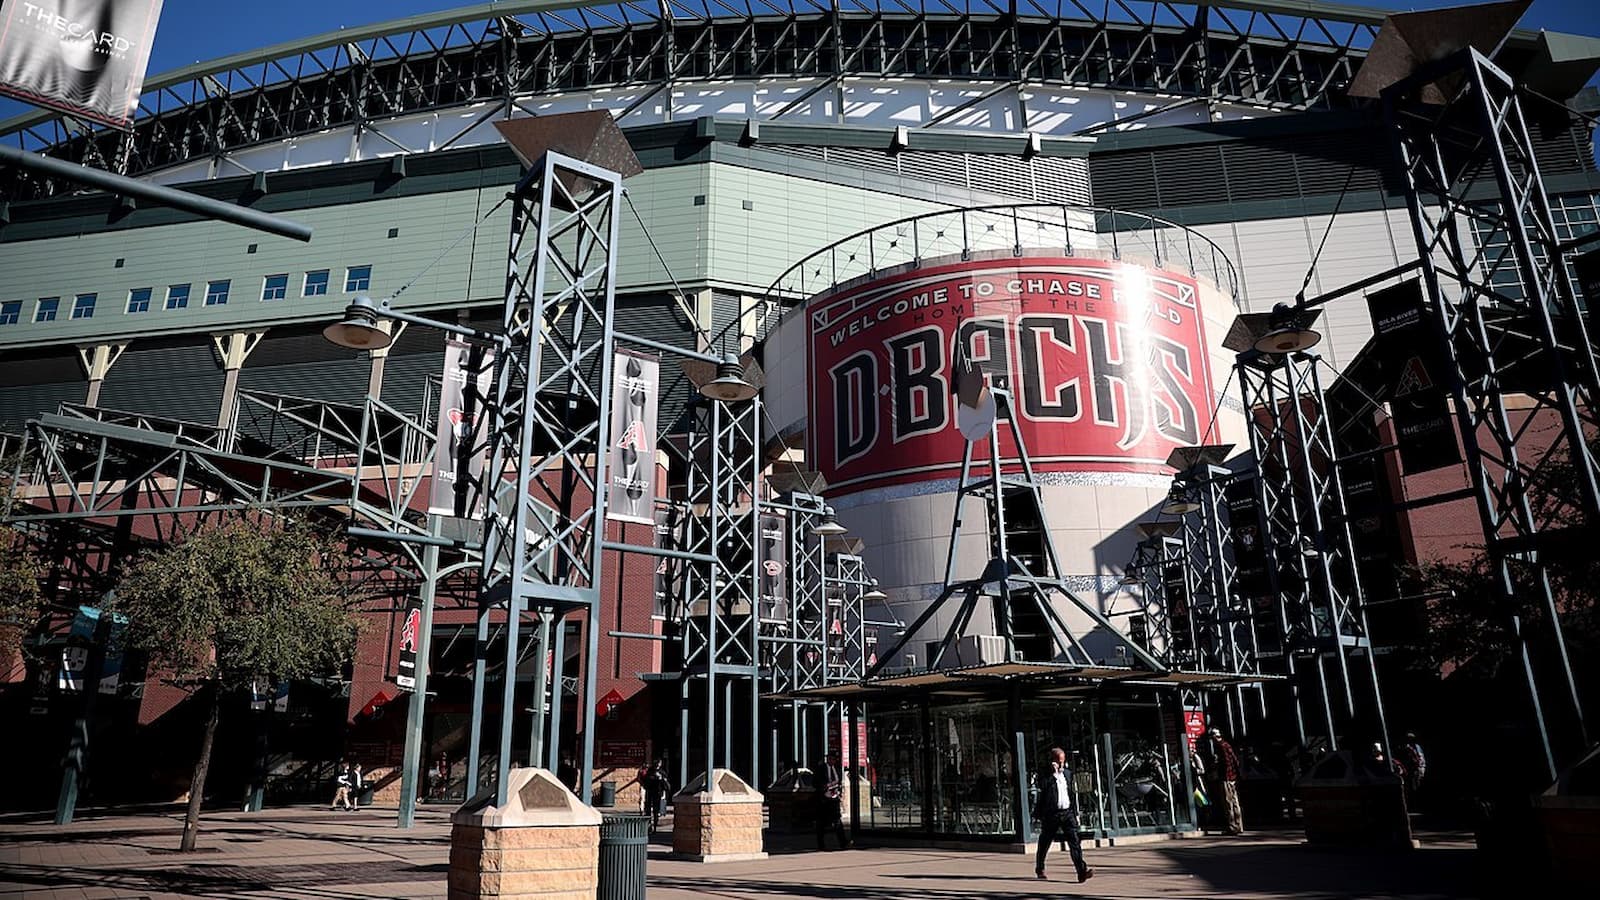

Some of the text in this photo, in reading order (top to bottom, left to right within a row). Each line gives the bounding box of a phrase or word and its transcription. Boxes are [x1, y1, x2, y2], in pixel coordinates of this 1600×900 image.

[830, 279, 1182, 347] WELCOME TO CHASE FLD
[913, 303, 981, 324] HOME
[1049, 298, 1097, 313] THE
